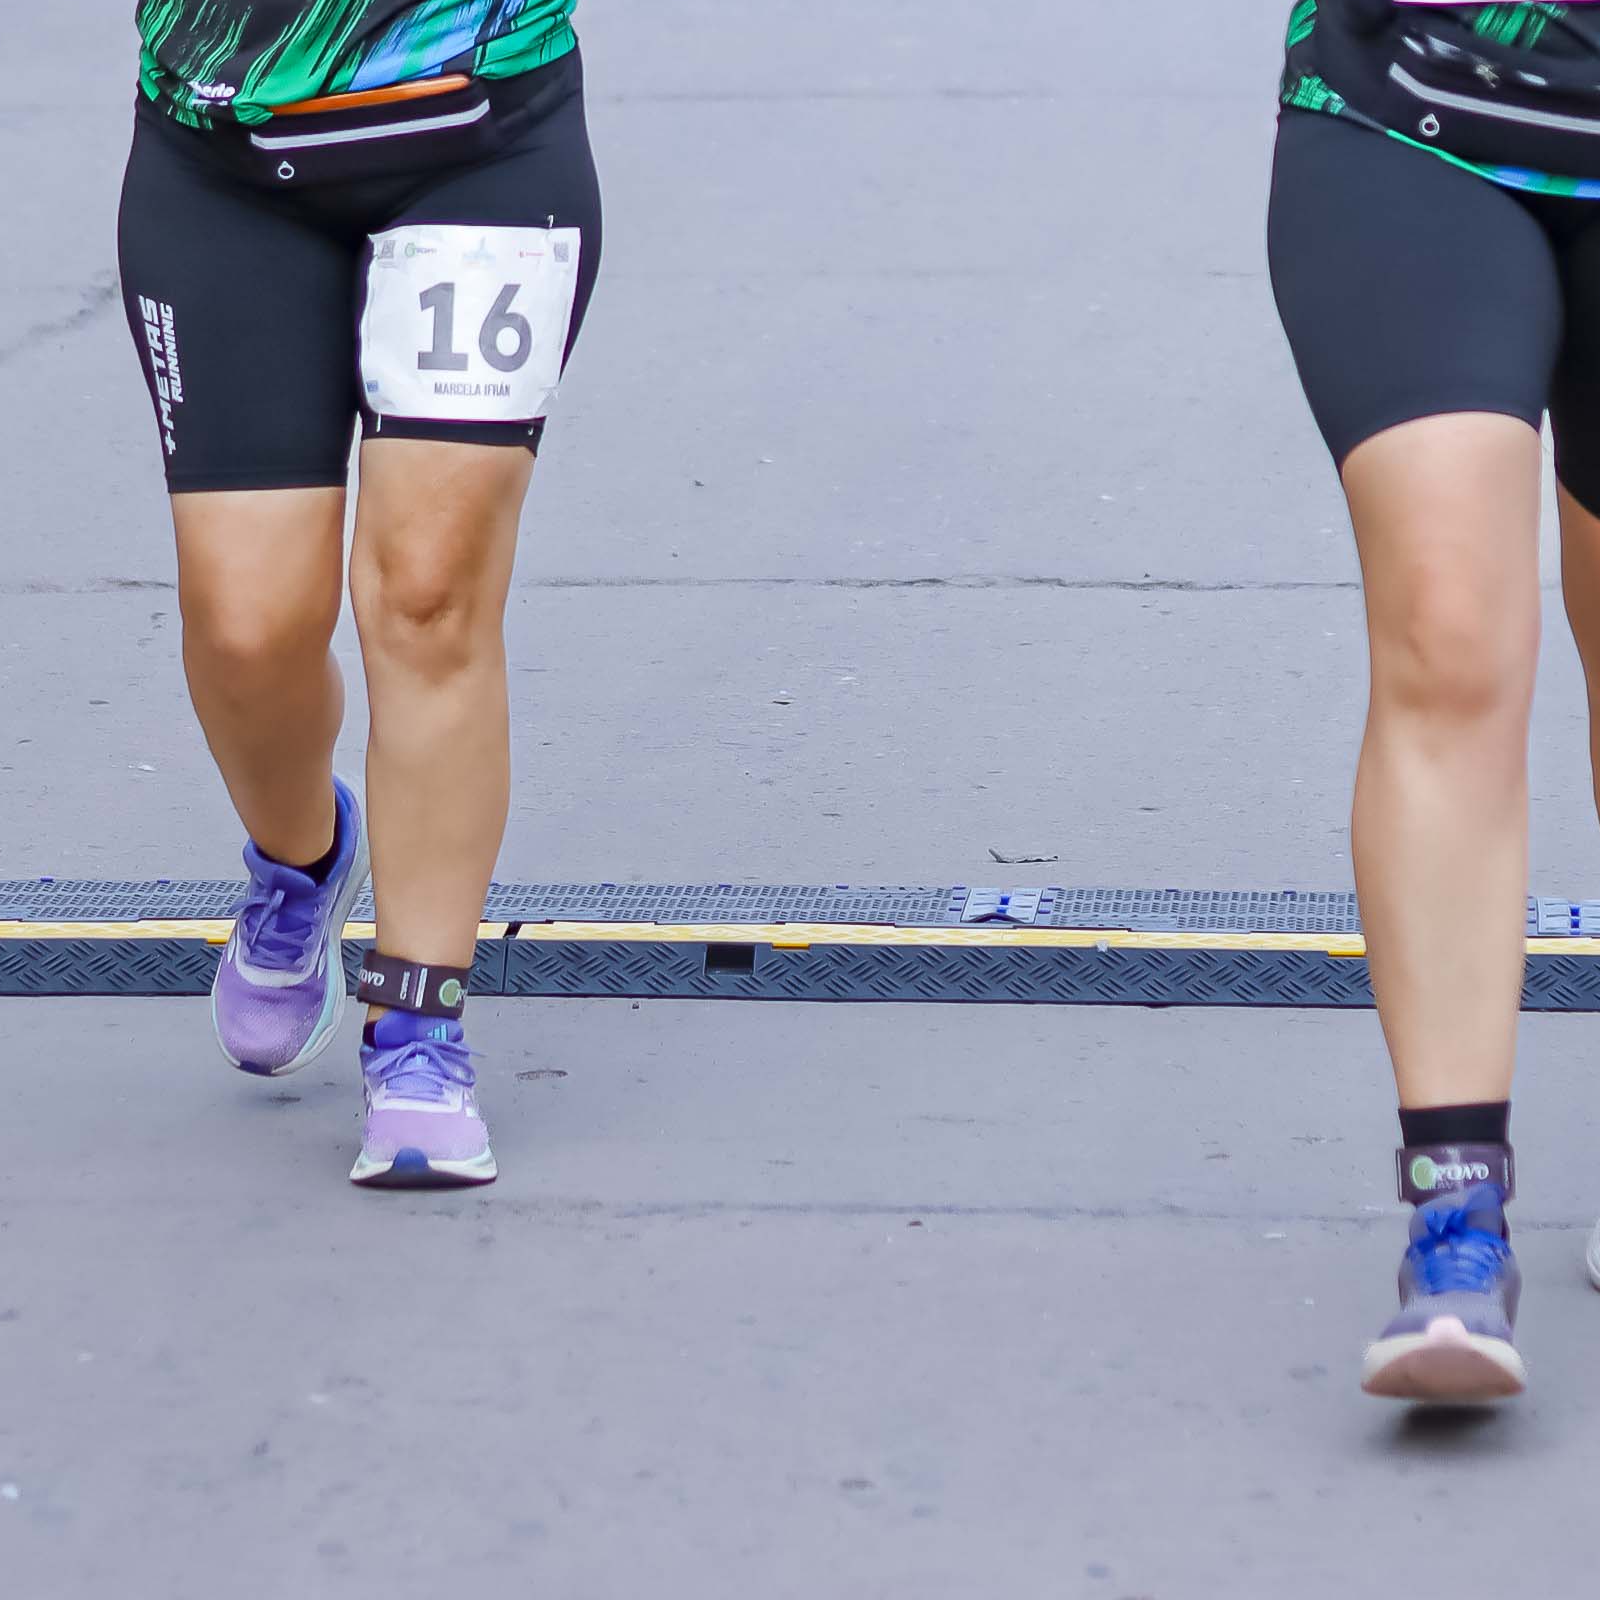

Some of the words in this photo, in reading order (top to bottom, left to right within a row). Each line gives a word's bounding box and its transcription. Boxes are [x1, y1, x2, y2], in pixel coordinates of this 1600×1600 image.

[139, 295, 177, 455] +METAS
[160, 303, 184, 403] RUNNING
[417, 282, 532, 373] 16
[434, 382, 481, 397] MARCELA
